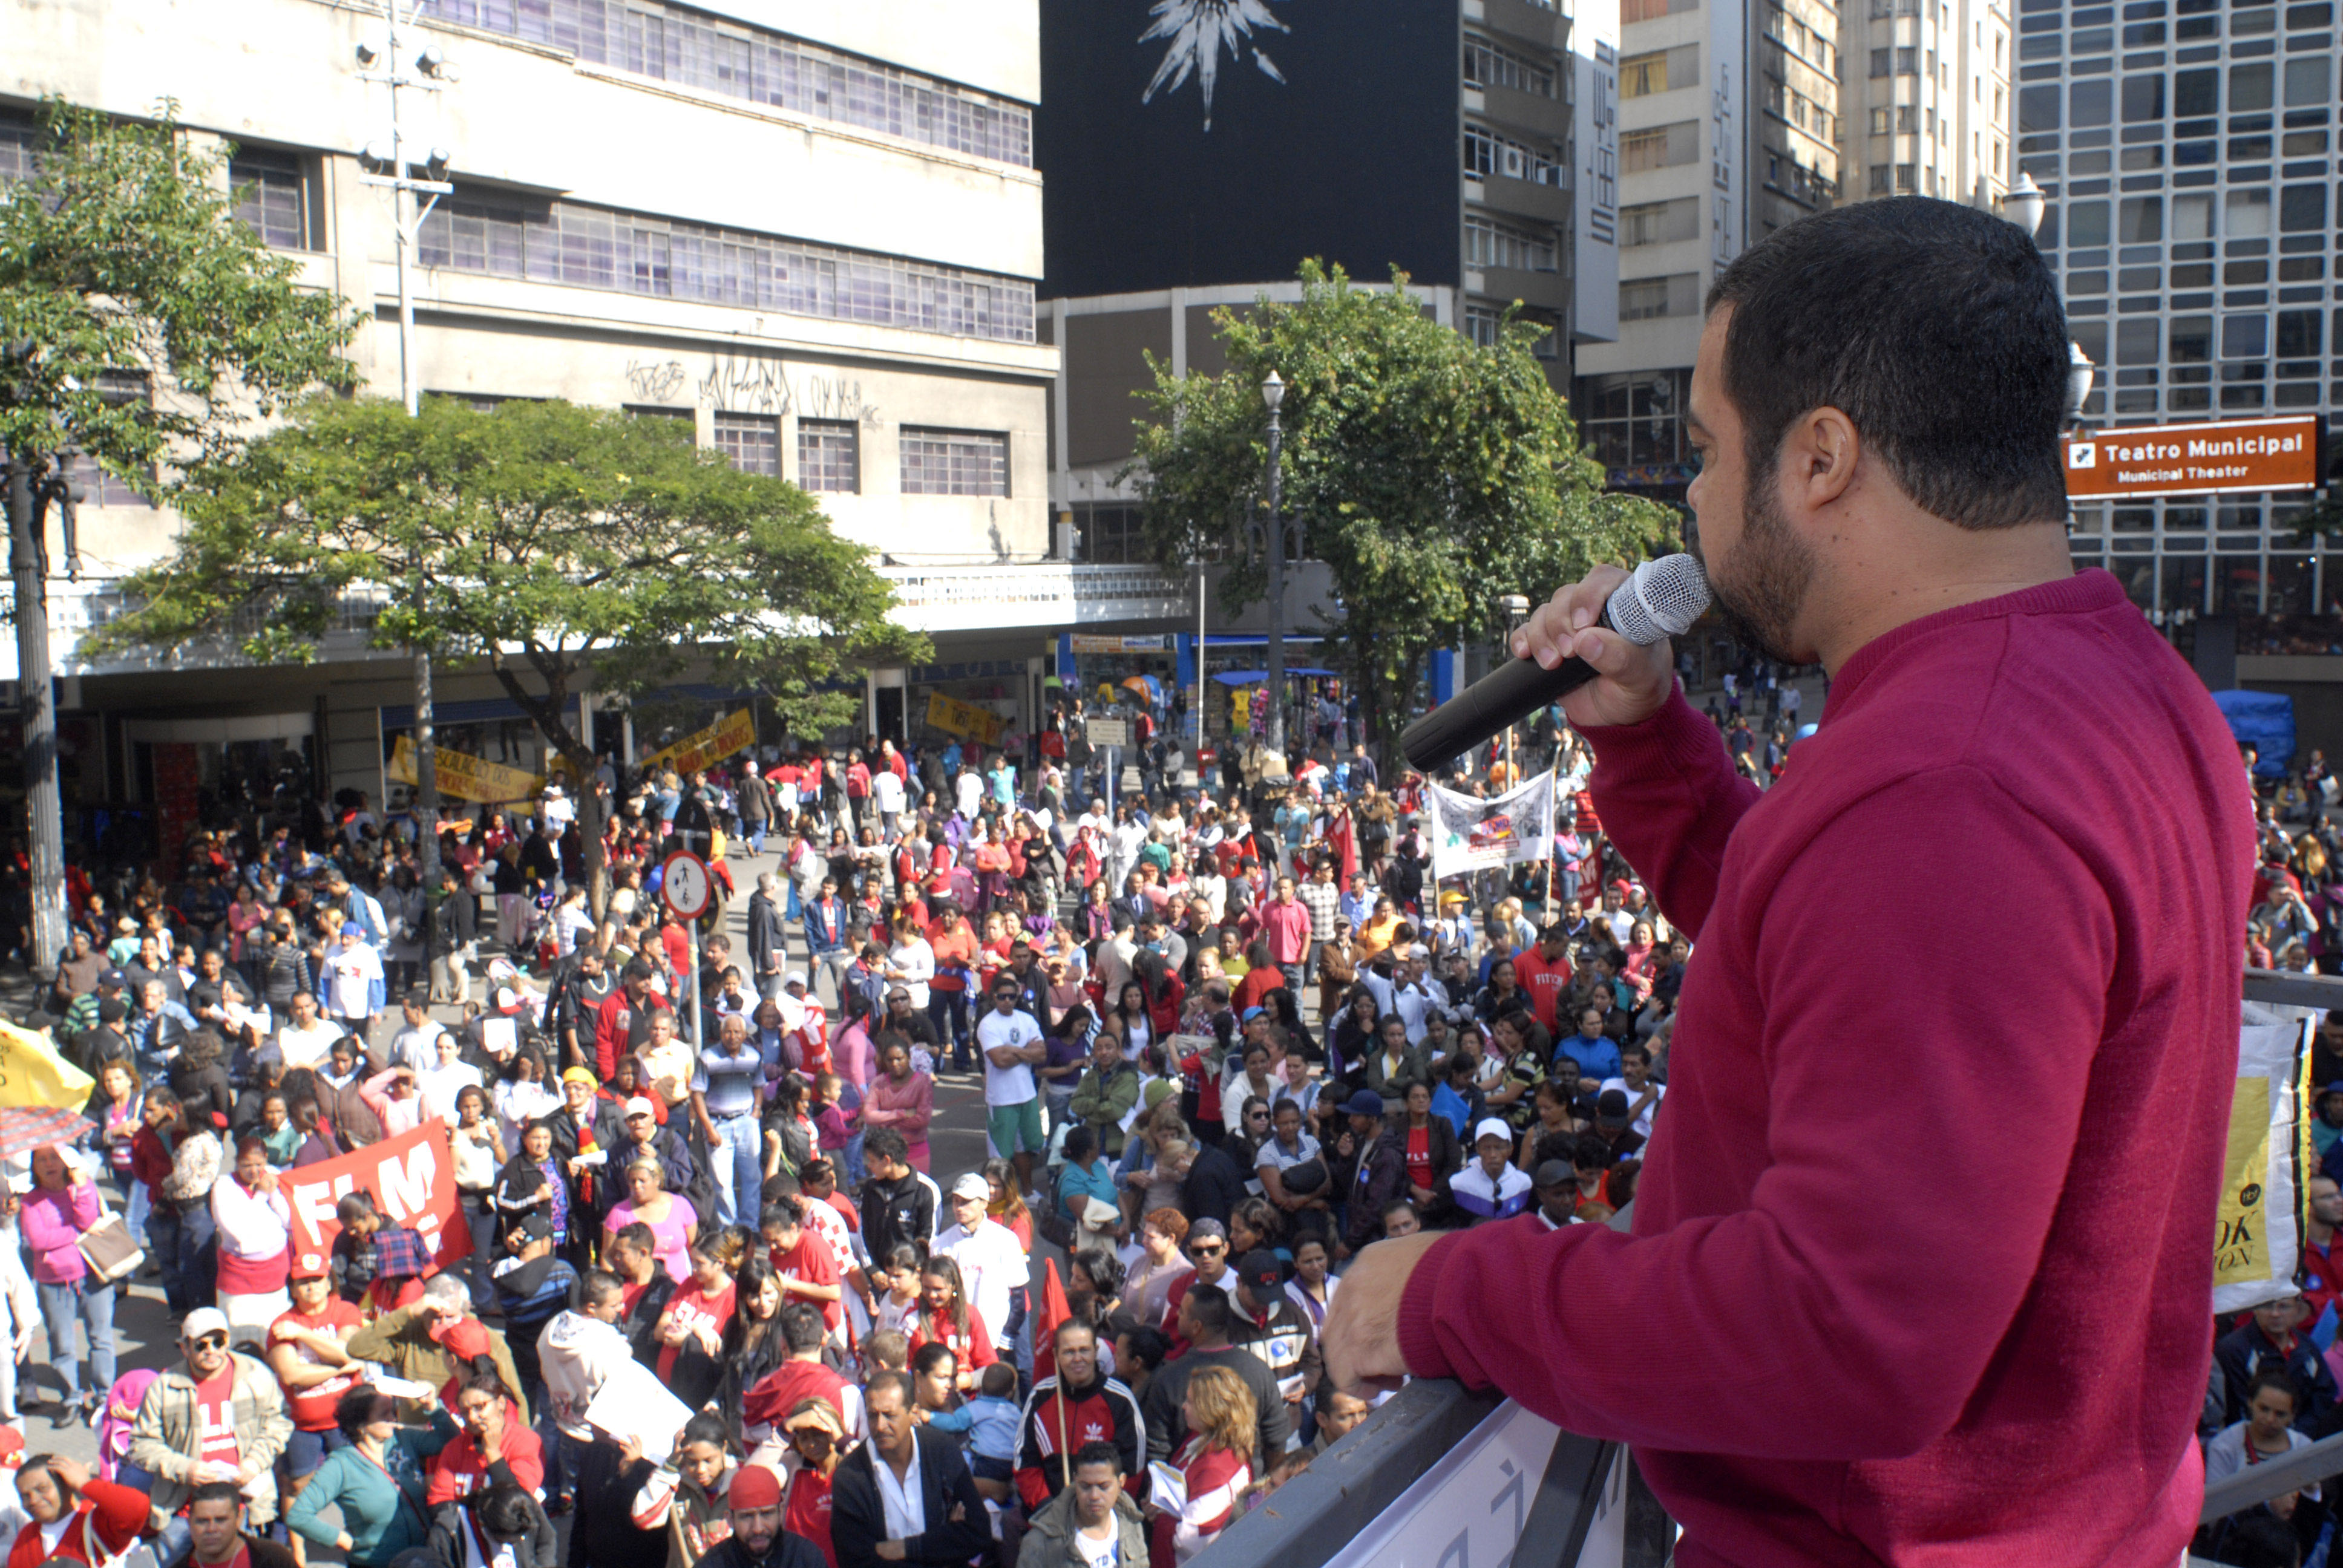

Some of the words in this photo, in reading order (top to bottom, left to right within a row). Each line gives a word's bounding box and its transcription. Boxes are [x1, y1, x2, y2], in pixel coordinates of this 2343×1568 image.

[2104, 442, 2181, 463] Teatro
[2187, 433, 2302, 457] Municipal
[2117, 467, 2183, 483] Municipal
[2187, 465, 2249, 479] Theater
